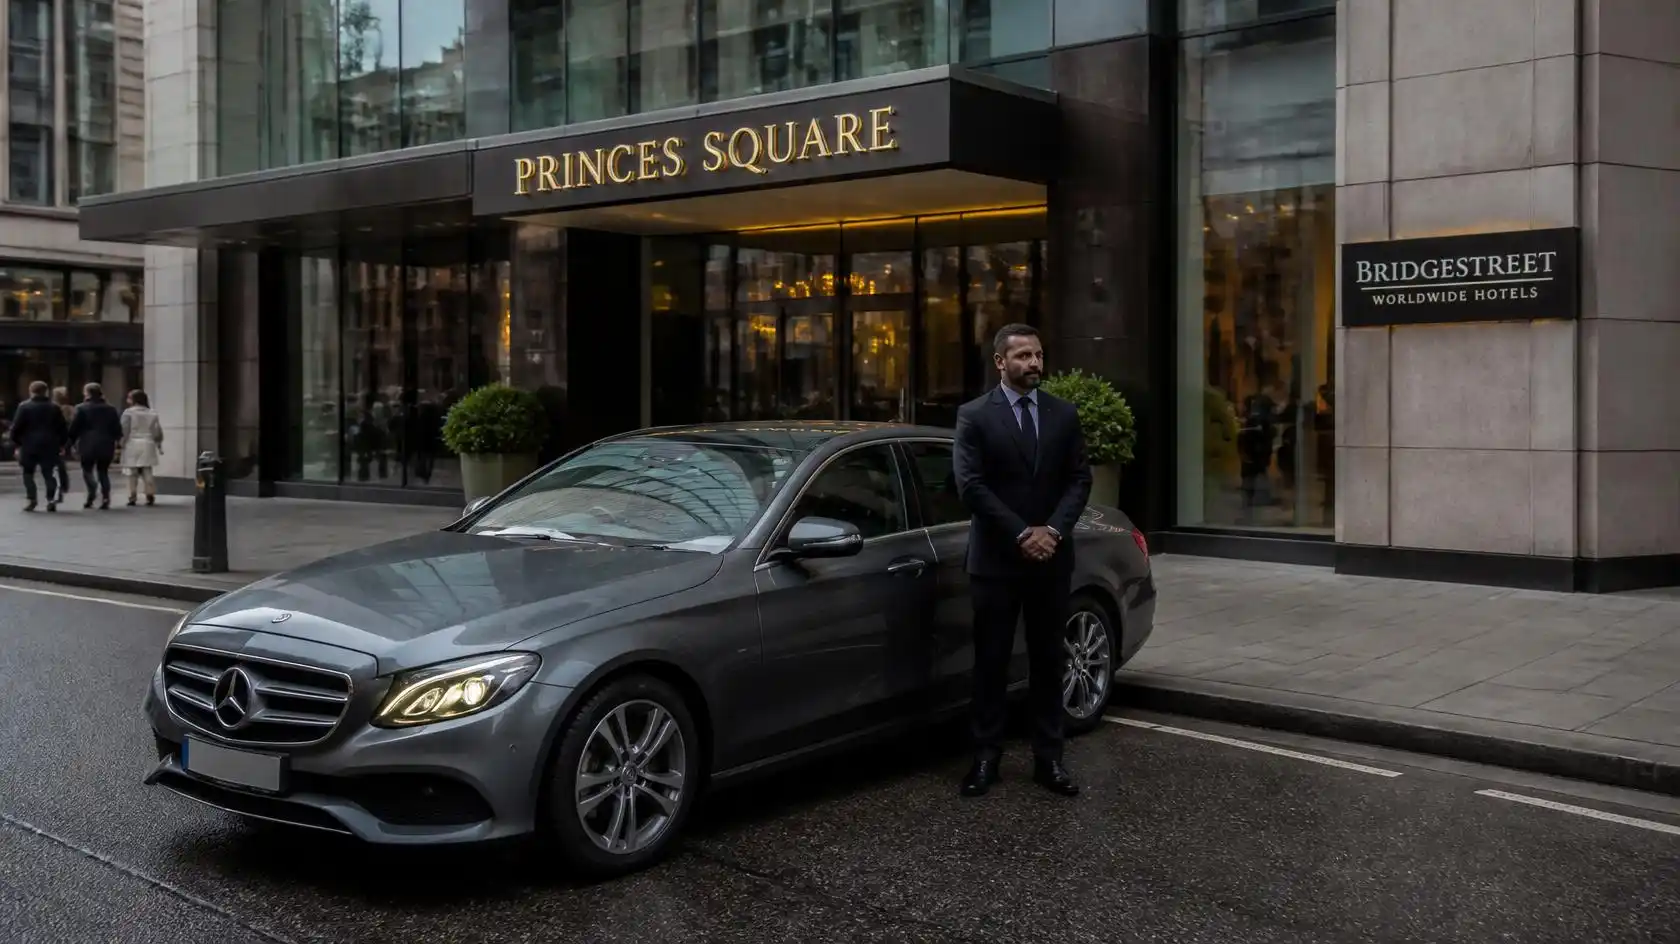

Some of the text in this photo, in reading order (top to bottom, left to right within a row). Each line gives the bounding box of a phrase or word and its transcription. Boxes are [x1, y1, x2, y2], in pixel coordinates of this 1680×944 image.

[514, 105, 899, 195] PRINCES SQUARE
[1356, 251, 1557, 283] BRIDGESTREET
[1372, 286, 1538, 305] WORLDWIDE HOTELS
